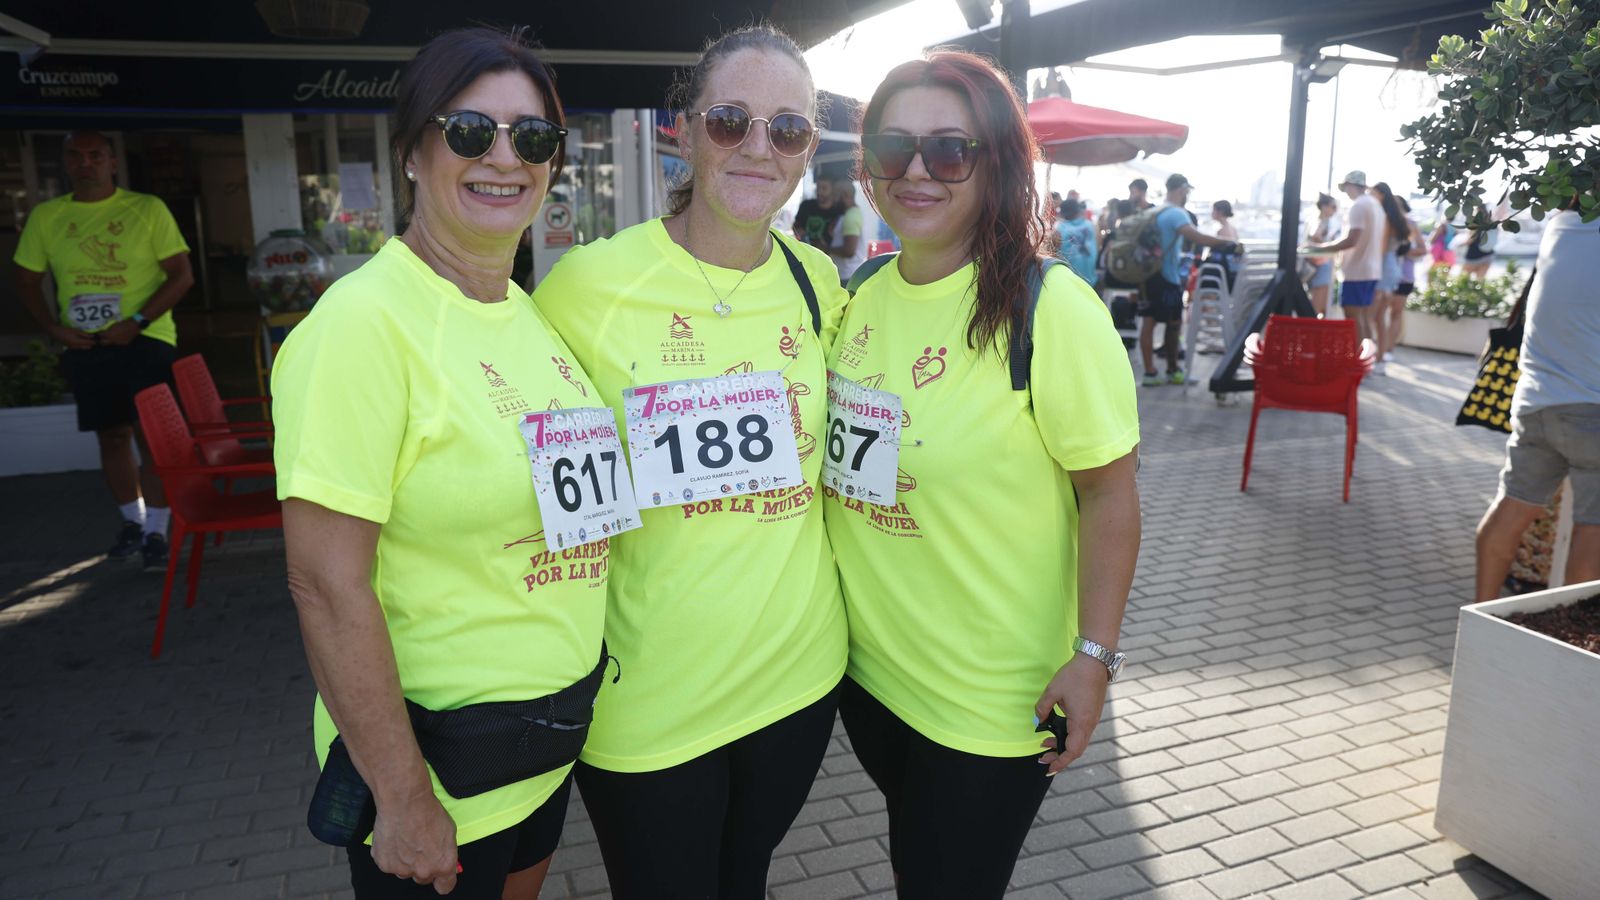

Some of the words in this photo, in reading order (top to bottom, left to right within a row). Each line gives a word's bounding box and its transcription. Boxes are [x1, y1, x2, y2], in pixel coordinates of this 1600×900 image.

[18, 67, 119, 87] Cruzcampo
[40, 87, 103, 97] ESPECIAL
[74, 304, 113, 322] 326
[634, 384, 668, 418] 7ª
[672, 376, 769, 398] CARRERA
[656, 398, 694, 414] POR
[699, 397, 720, 409] LA
[724, 389, 778, 405] MUJER
[838, 394, 847, 409] LA
[848, 401, 893, 421] MUJER
[545, 430, 572, 446] POR
[574, 428, 588, 441] LA
[589, 425, 614, 439] MUJER
[654, 414, 774, 475] 188
[827, 411, 879, 471] 67
[552, 450, 618, 512] 617
[681, 499, 723, 519] POR
[729, 498, 755, 513] LA
[762, 486, 814, 516] MUJER
[844, 497, 865, 514] LA
[870, 508, 919, 531] MUJER
[523, 564, 563, 593] POR
[573, 563, 592, 580] LA
